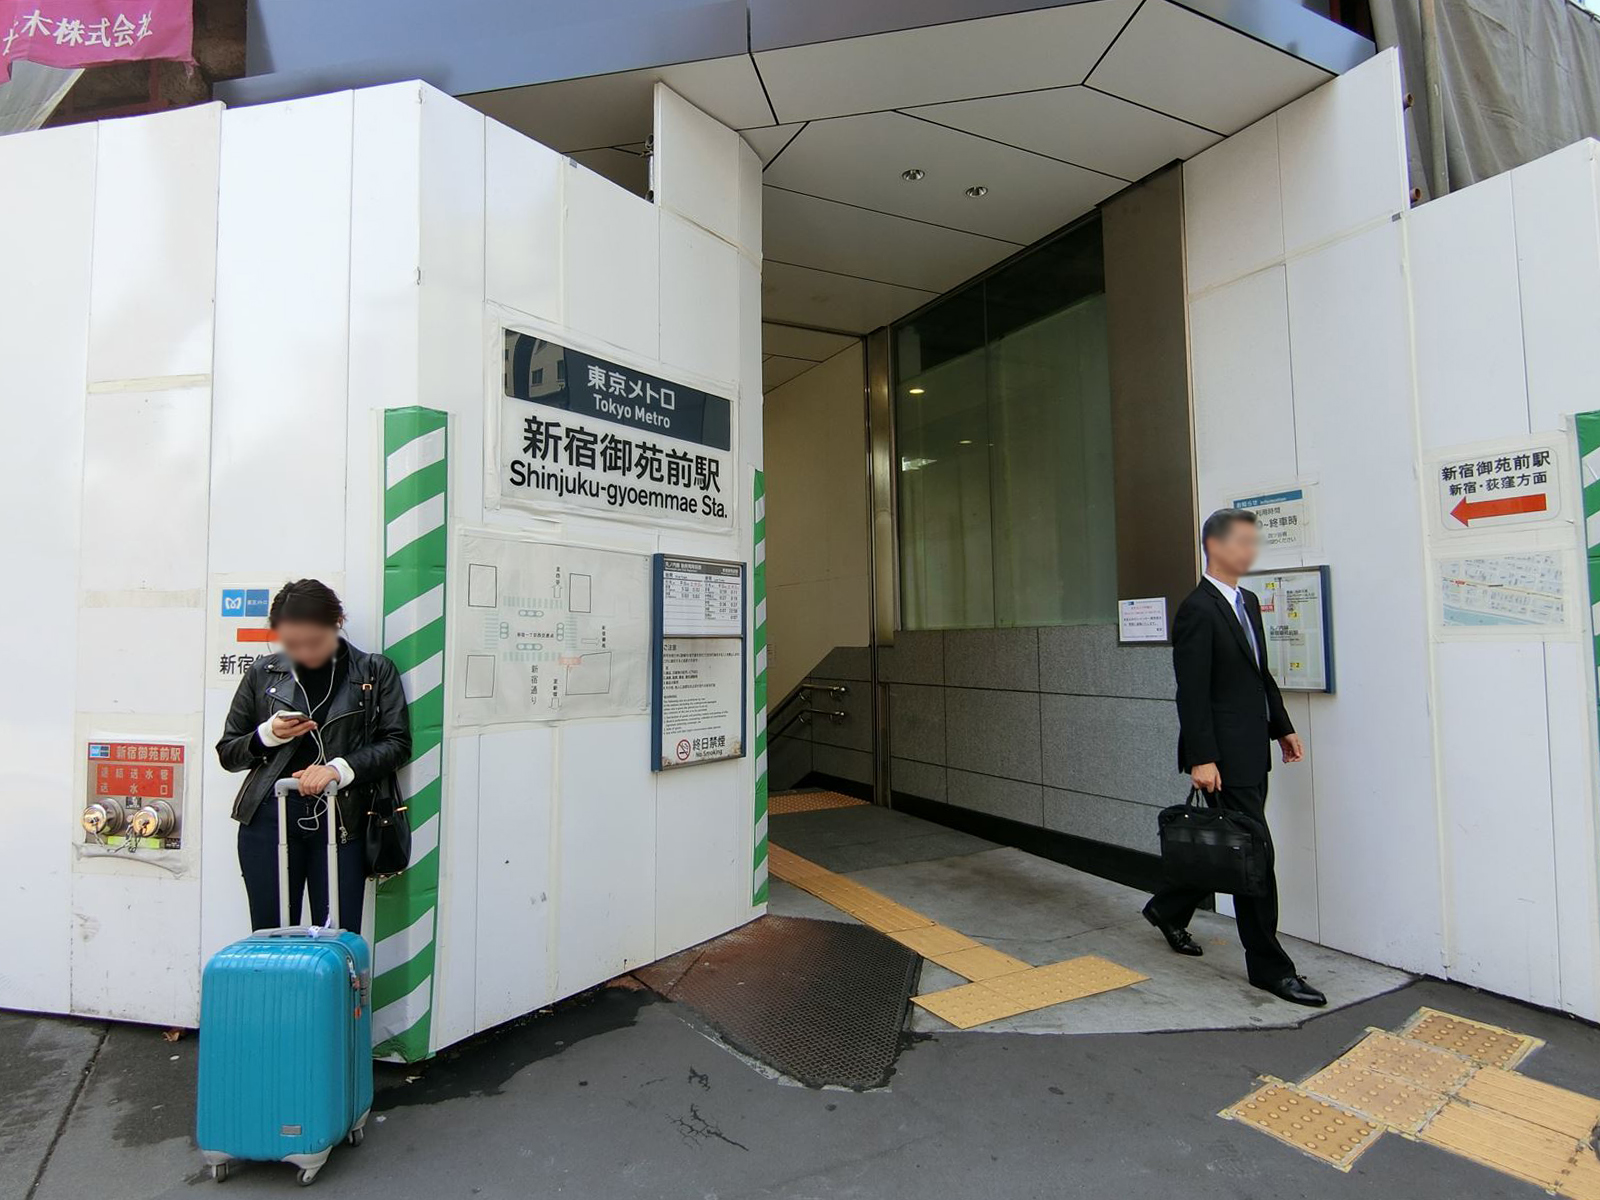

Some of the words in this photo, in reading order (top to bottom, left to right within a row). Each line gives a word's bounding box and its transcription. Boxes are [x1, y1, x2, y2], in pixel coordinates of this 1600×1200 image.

[587, 365, 675, 410] 東京メトロ
[593, 393, 632, 418] Tokyo
[634, 410, 671, 428] Metro
[523, 416, 721, 493] 新宿御苑前駅
[1441, 451, 1551, 481] 新宿御苑前駅
[509, 460, 697, 513] Shinjuku-gyoemmae
[702, 495, 728, 518] Sta.
[1449, 471, 1547, 496] 新宿・荻窪方面
[219, 653, 263, 675] 新宿
[116, 745, 181, 761] 新宿御苑前駅
[692, 735, 726, 751] 終日禁煙
